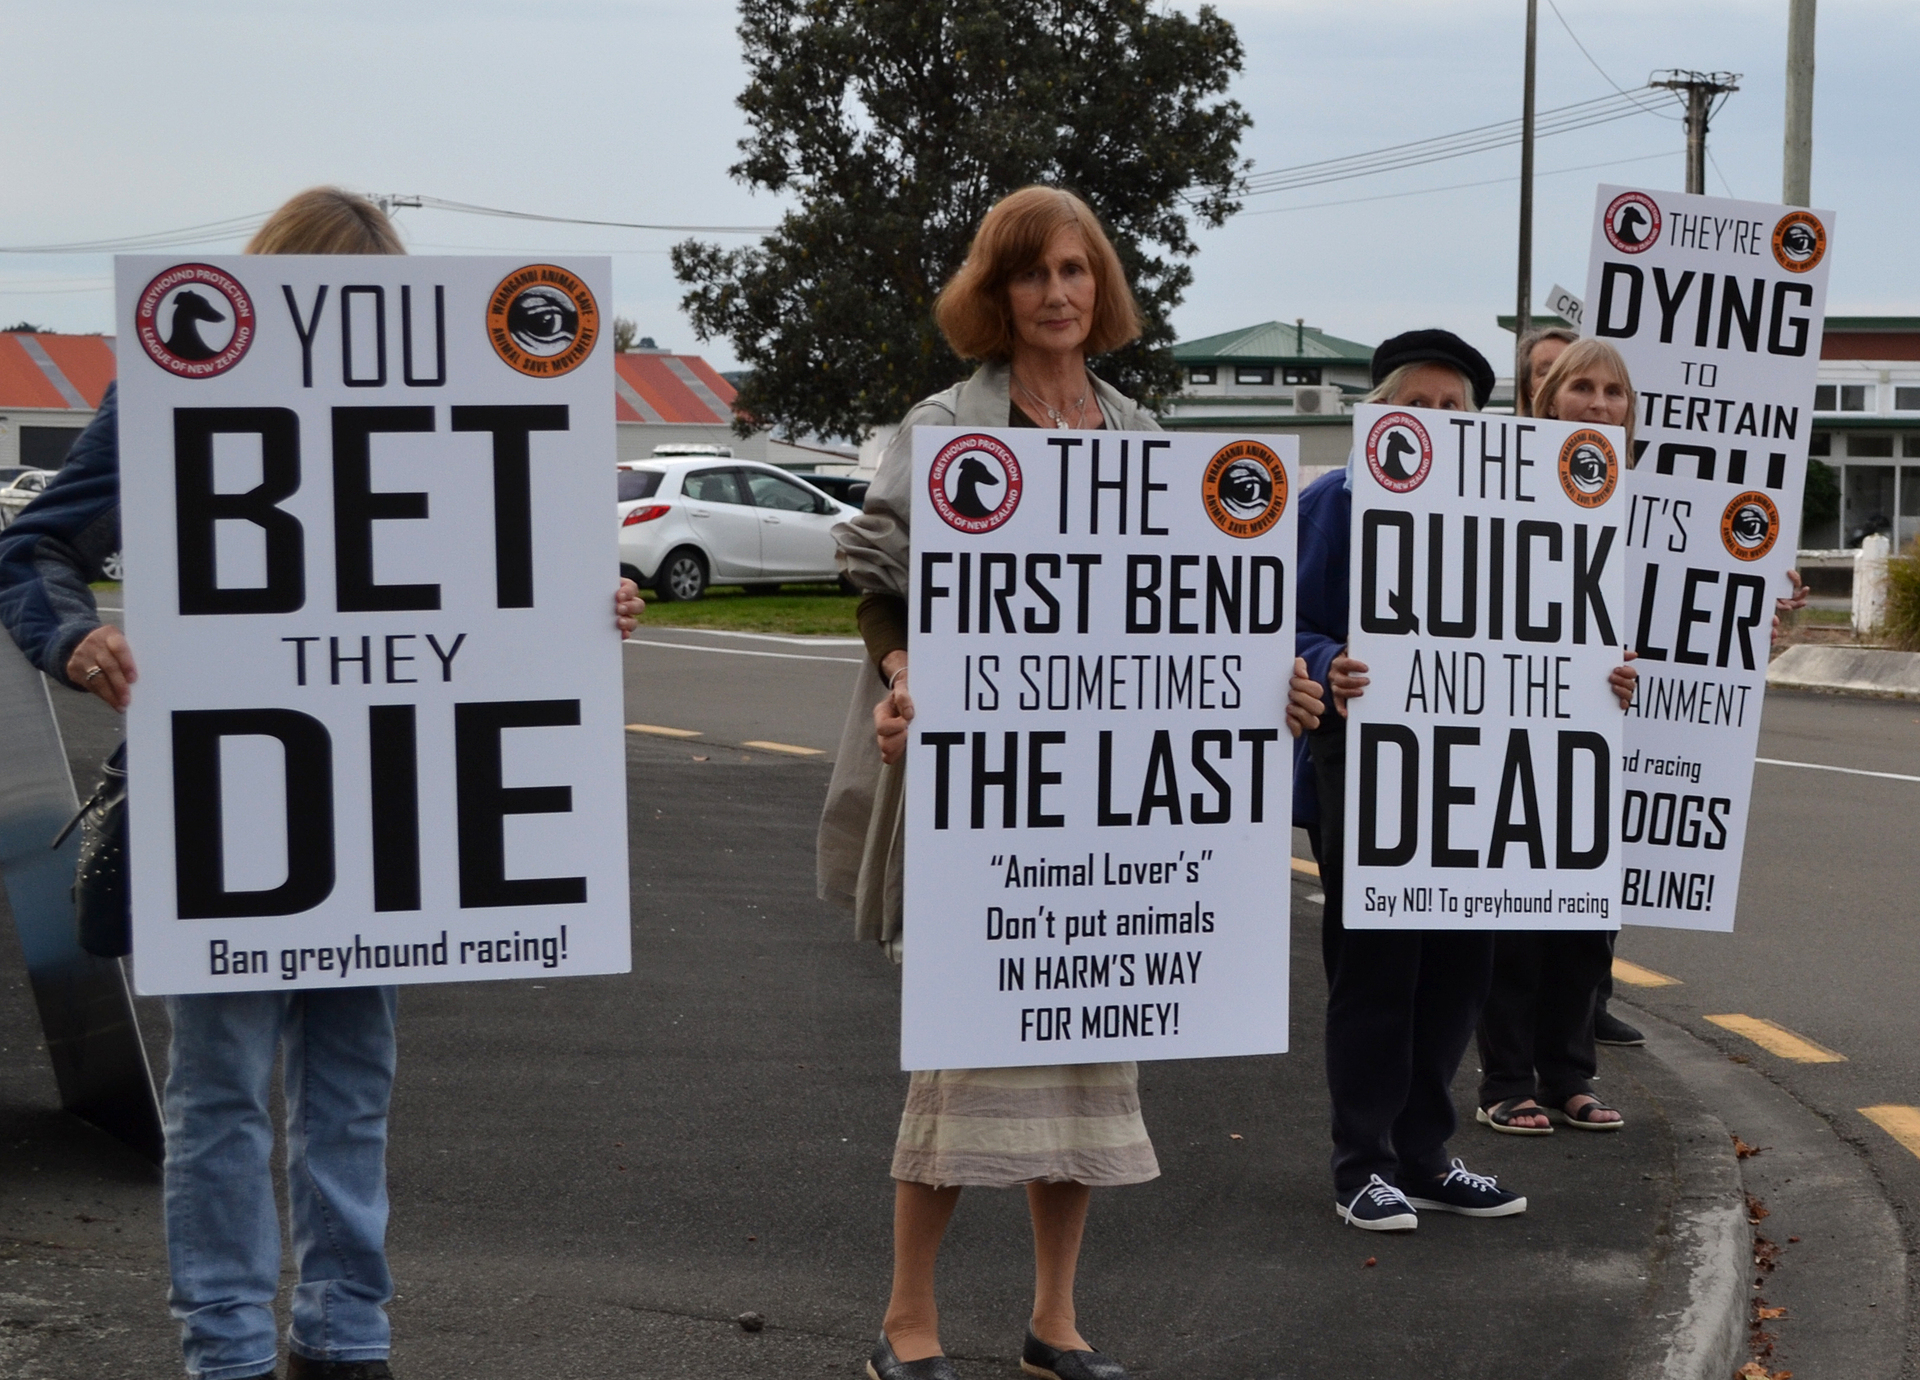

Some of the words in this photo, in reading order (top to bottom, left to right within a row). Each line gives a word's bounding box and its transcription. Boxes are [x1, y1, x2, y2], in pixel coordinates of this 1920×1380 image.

[1669, 211, 1764, 256] THEY'RE
[142, 269, 195, 318] GREYHOUND
[196, 269, 251, 318] PROTECTION
[541, 269, 578, 294] ANIMAL
[575, 291, 593, 316] SAVE
[1595, 261, 1814, 358] DYING
[142, 327, 171, 364] LEAGUE
[170, 360, 187, 371] OF
[187, 363, 215, 374] NEW
[215, 326, 250, 369] ZEALAND
[280, 284, 447, 389] YOU
[492, 328, 520, 364] ANIMAL
[522, 358, 548, 373] SAVE
[551, 326, 594, 372] MOVEMENT
[1680, 361, 1718, 388] TO
[1634, 390, 1799, 441] TERTAIN
[933, 438, 977, 480] GREYHOUND
[977, 439, 1019, 481] PROTECTION
[1046, 437, 1171, 536] THE
[1449, 417, 1537, 503] THE
[172, 403, 570, 617] BET
[933, 488, 956, 521] LEAGUE
[954, 517, 968, 527] OF
[967, 520, 989, 530] NEW
[989, 489, 1018, 526] ZEALAND
[1206, 494, 1227, 526] ANIMAL
[919, 551, 1103, 635] FIRST
[1125, 553, 1285, 635] BEND
[1360, 508, 1619, 647] QUICK
[1623, 562, 1766, 671] LER
[280, 632, 468, 687] THEY
[964, 654, 1000, 712] IS
[1019, 654, 1242, 711] SOMETIMES
[1404, 648, 1486, 716] AND
[1502, 653, 1572, 719] THE
[1623, 674, 1752, 728] AINMENT
[920, 730, 1067, 831] THE
[1096, 728, 1279, 827] LAST
[1357, 722, 1611, 870] DEAD
[1644, 755, 1702, 784] racing
[170, 698, 588, 921] DIE
[1621, 789, 1732, 851] DOGS
[1365, 886, 1397, 918] Say
[1403, 887, 1433, 913] NO!
[1438, 887, 1458, 913] To
[1464, 888, 1553, 919] greyhound
[1558, 892, 1609, 919] racing
[1621, 867, 1715, 912] BLING!
[1065, 909, 1107, 946] put
[1116, 900, 1215, 937] animals
[209, 939, 269, 976] Ban
[280, 930, 448, 981] greyhound
[460, 924, 568, 969] racing!
[999, 957, 1025, 992] IN
[1144, 950, 1203, 986] WAY
[1021, 1006, 1072, 1042] FOR
[1081, 1002, 1179, 1040] MONEY!
